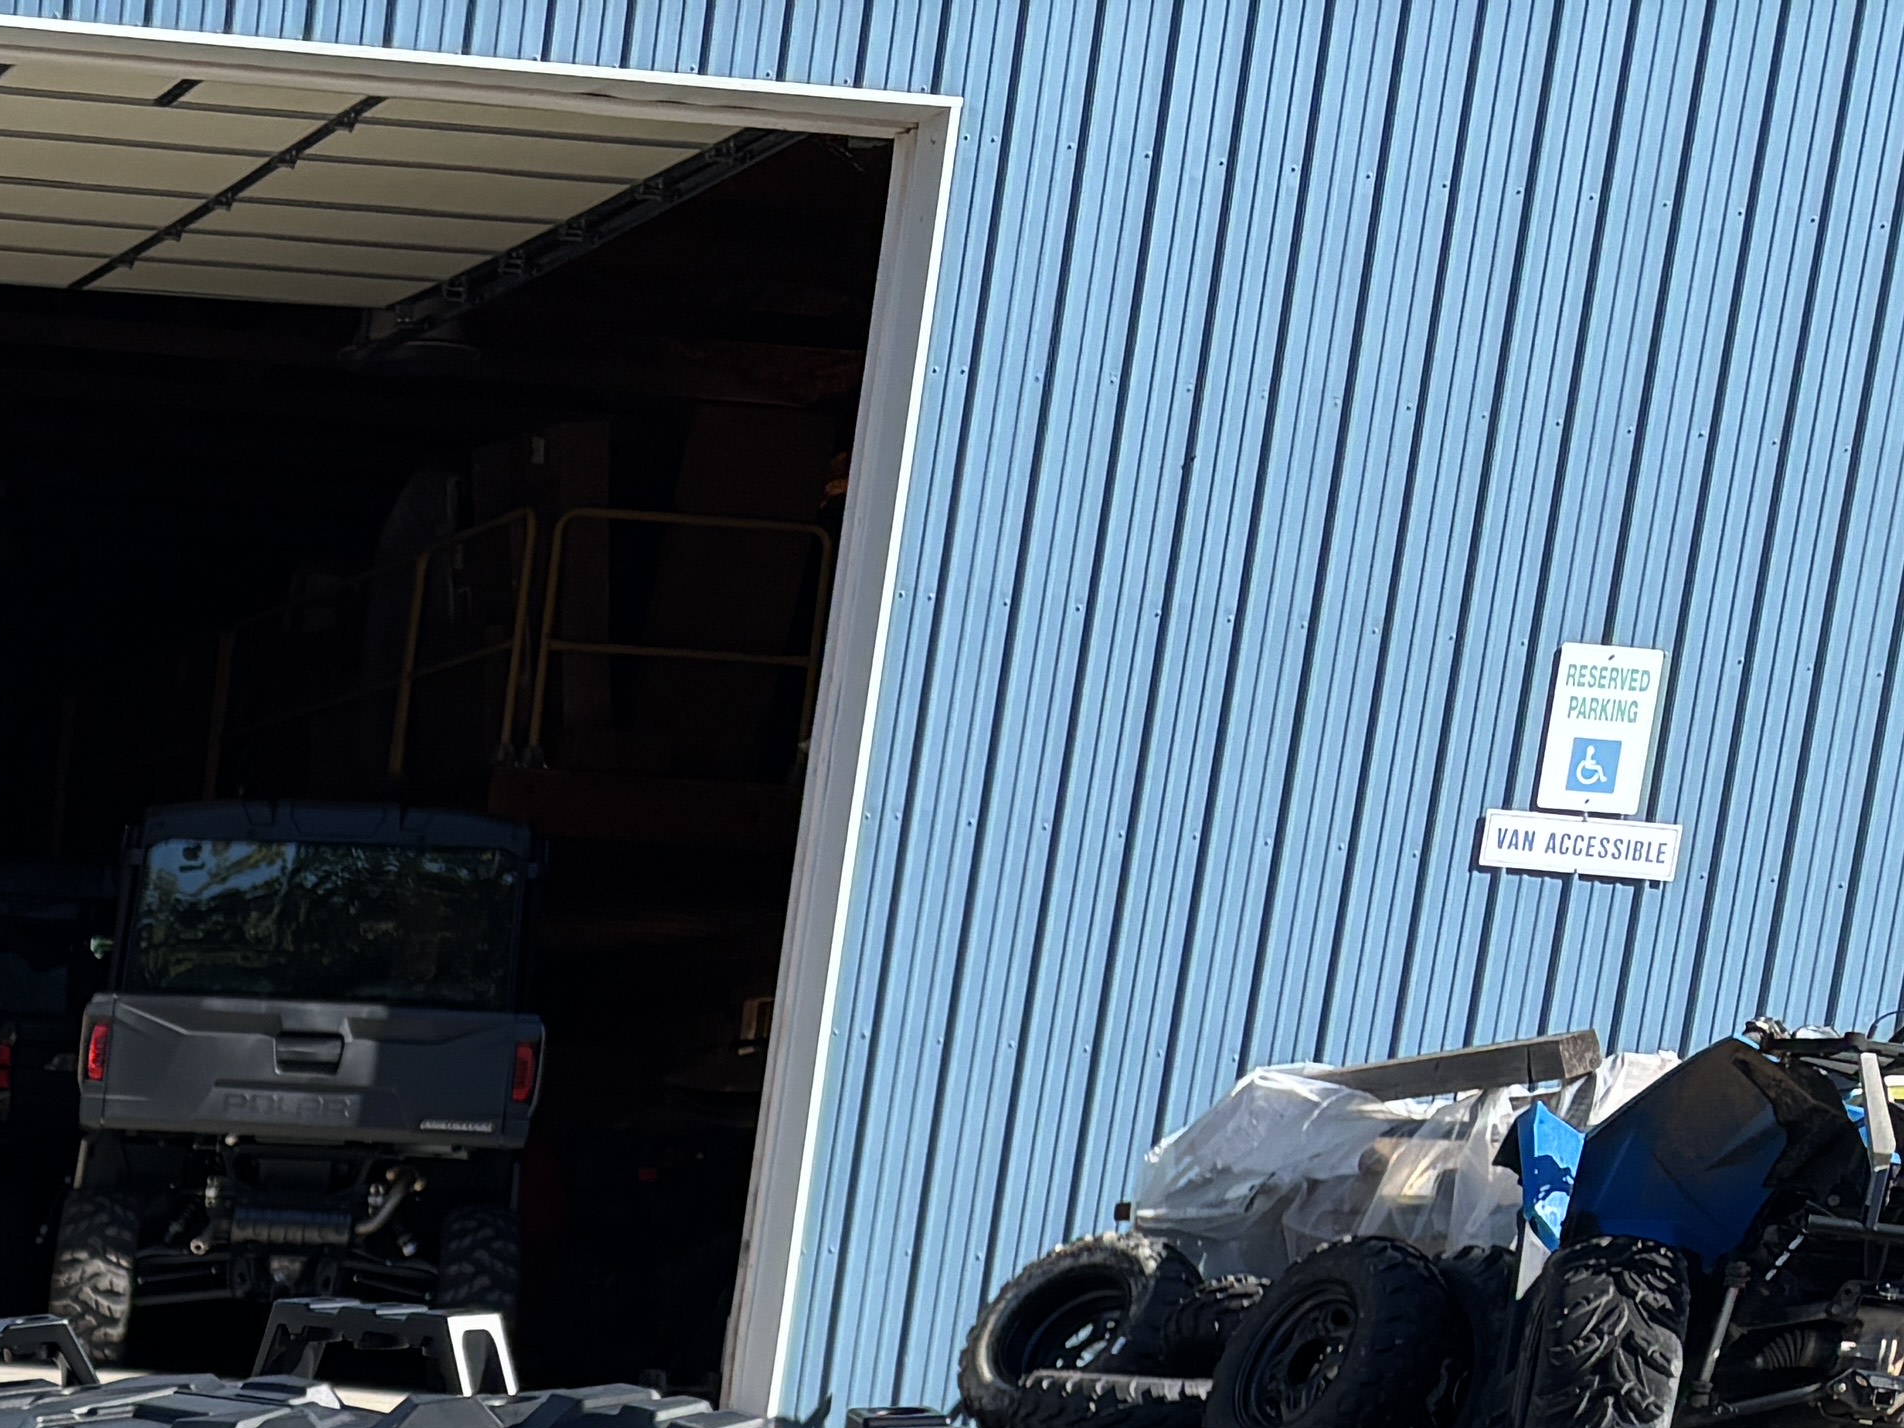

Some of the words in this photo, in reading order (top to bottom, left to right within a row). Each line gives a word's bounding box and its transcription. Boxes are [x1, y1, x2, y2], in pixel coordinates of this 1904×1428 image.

[1565, 663, 1651, 692] RESERVED
[1567, 695, 1639, 723] PARKING
[1496, 827, 1536, 851] VAN
[1544, 832, 1668, 864] ACCESSIBLE
